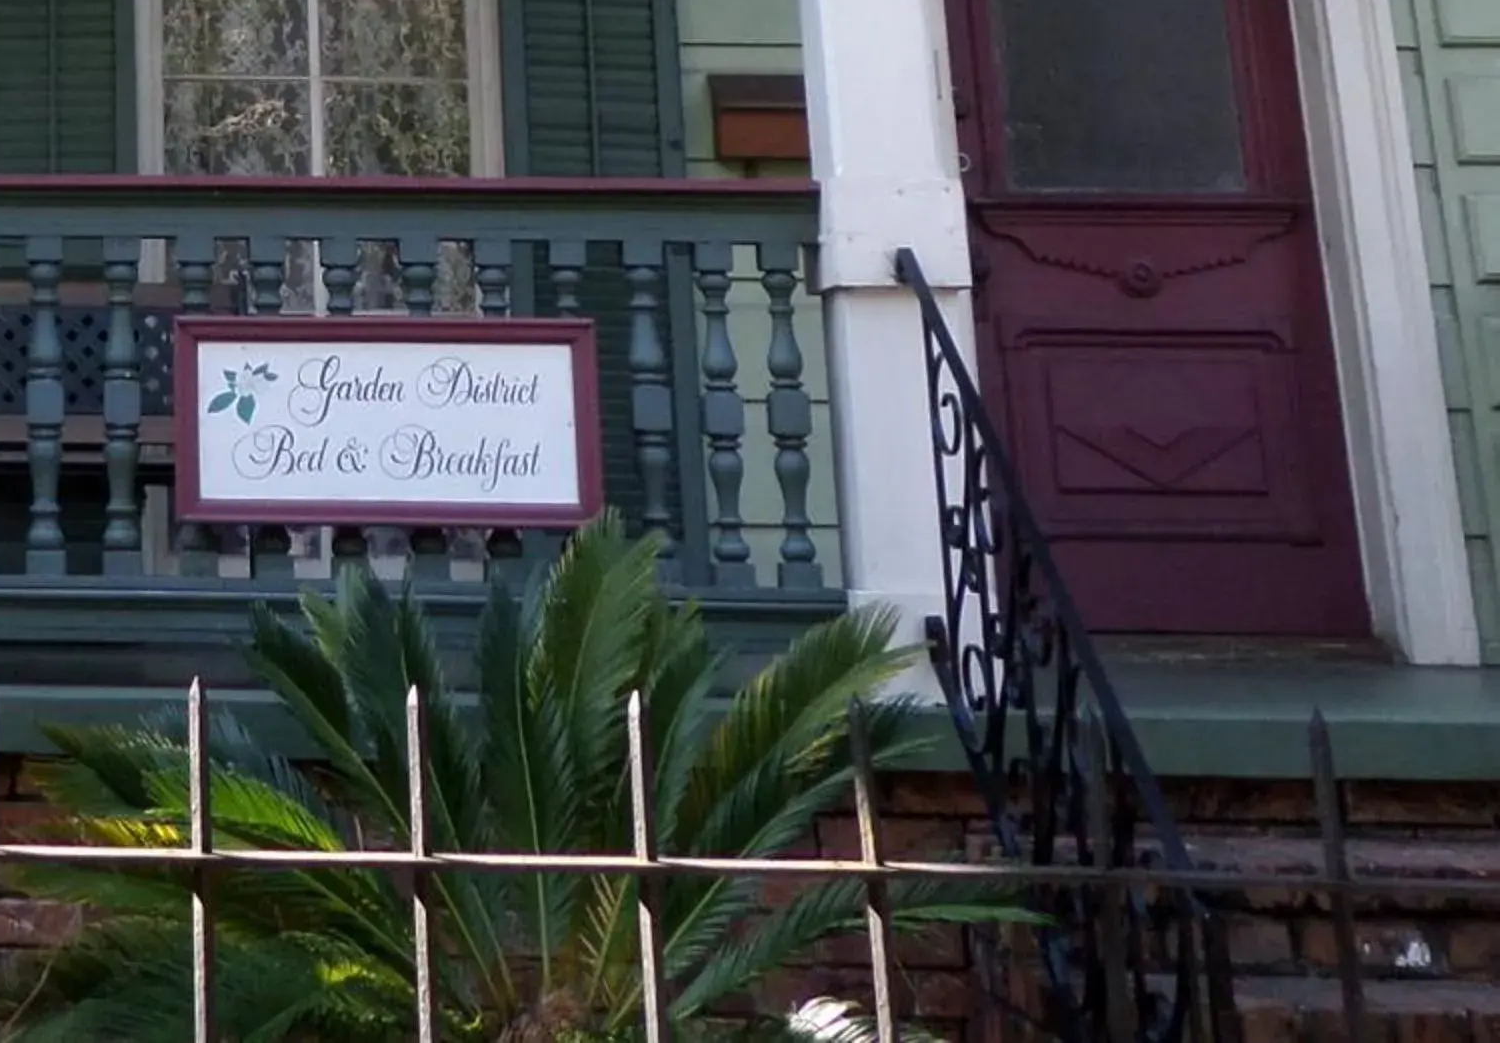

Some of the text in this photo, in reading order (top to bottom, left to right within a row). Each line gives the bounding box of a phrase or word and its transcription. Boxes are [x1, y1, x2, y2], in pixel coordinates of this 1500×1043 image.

[287, 354, 540, 427] Garden District
[232, 424, 542, 493] Bed & Breakfast
